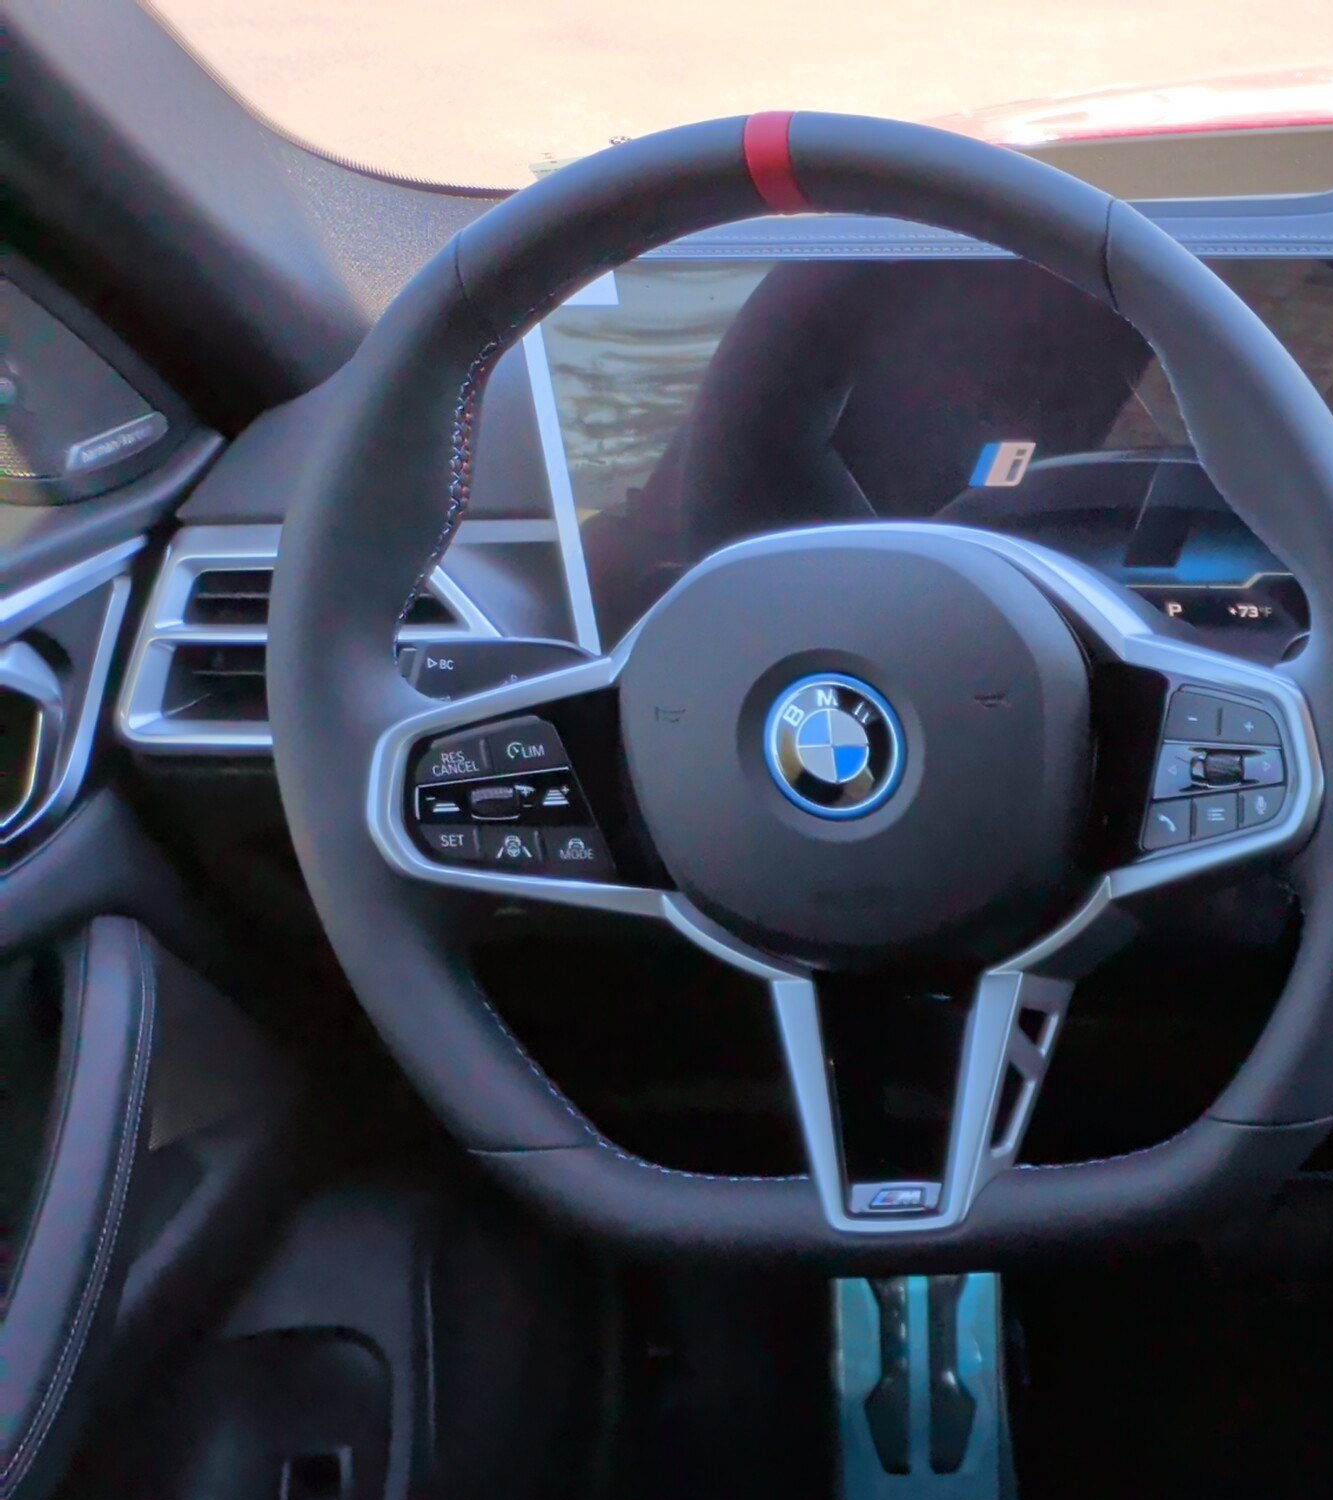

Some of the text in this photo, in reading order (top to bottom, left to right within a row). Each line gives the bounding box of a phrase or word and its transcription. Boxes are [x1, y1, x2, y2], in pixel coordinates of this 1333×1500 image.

[1167, 602, 1183, 617] P
[440, 750, 465, 765] RES
[522, 744, 545, 759] LIM
[432, 760, 480, 777] CANCEL
[440, 834, 465, 848] SET
[559, 848, 595, 860] MODE
